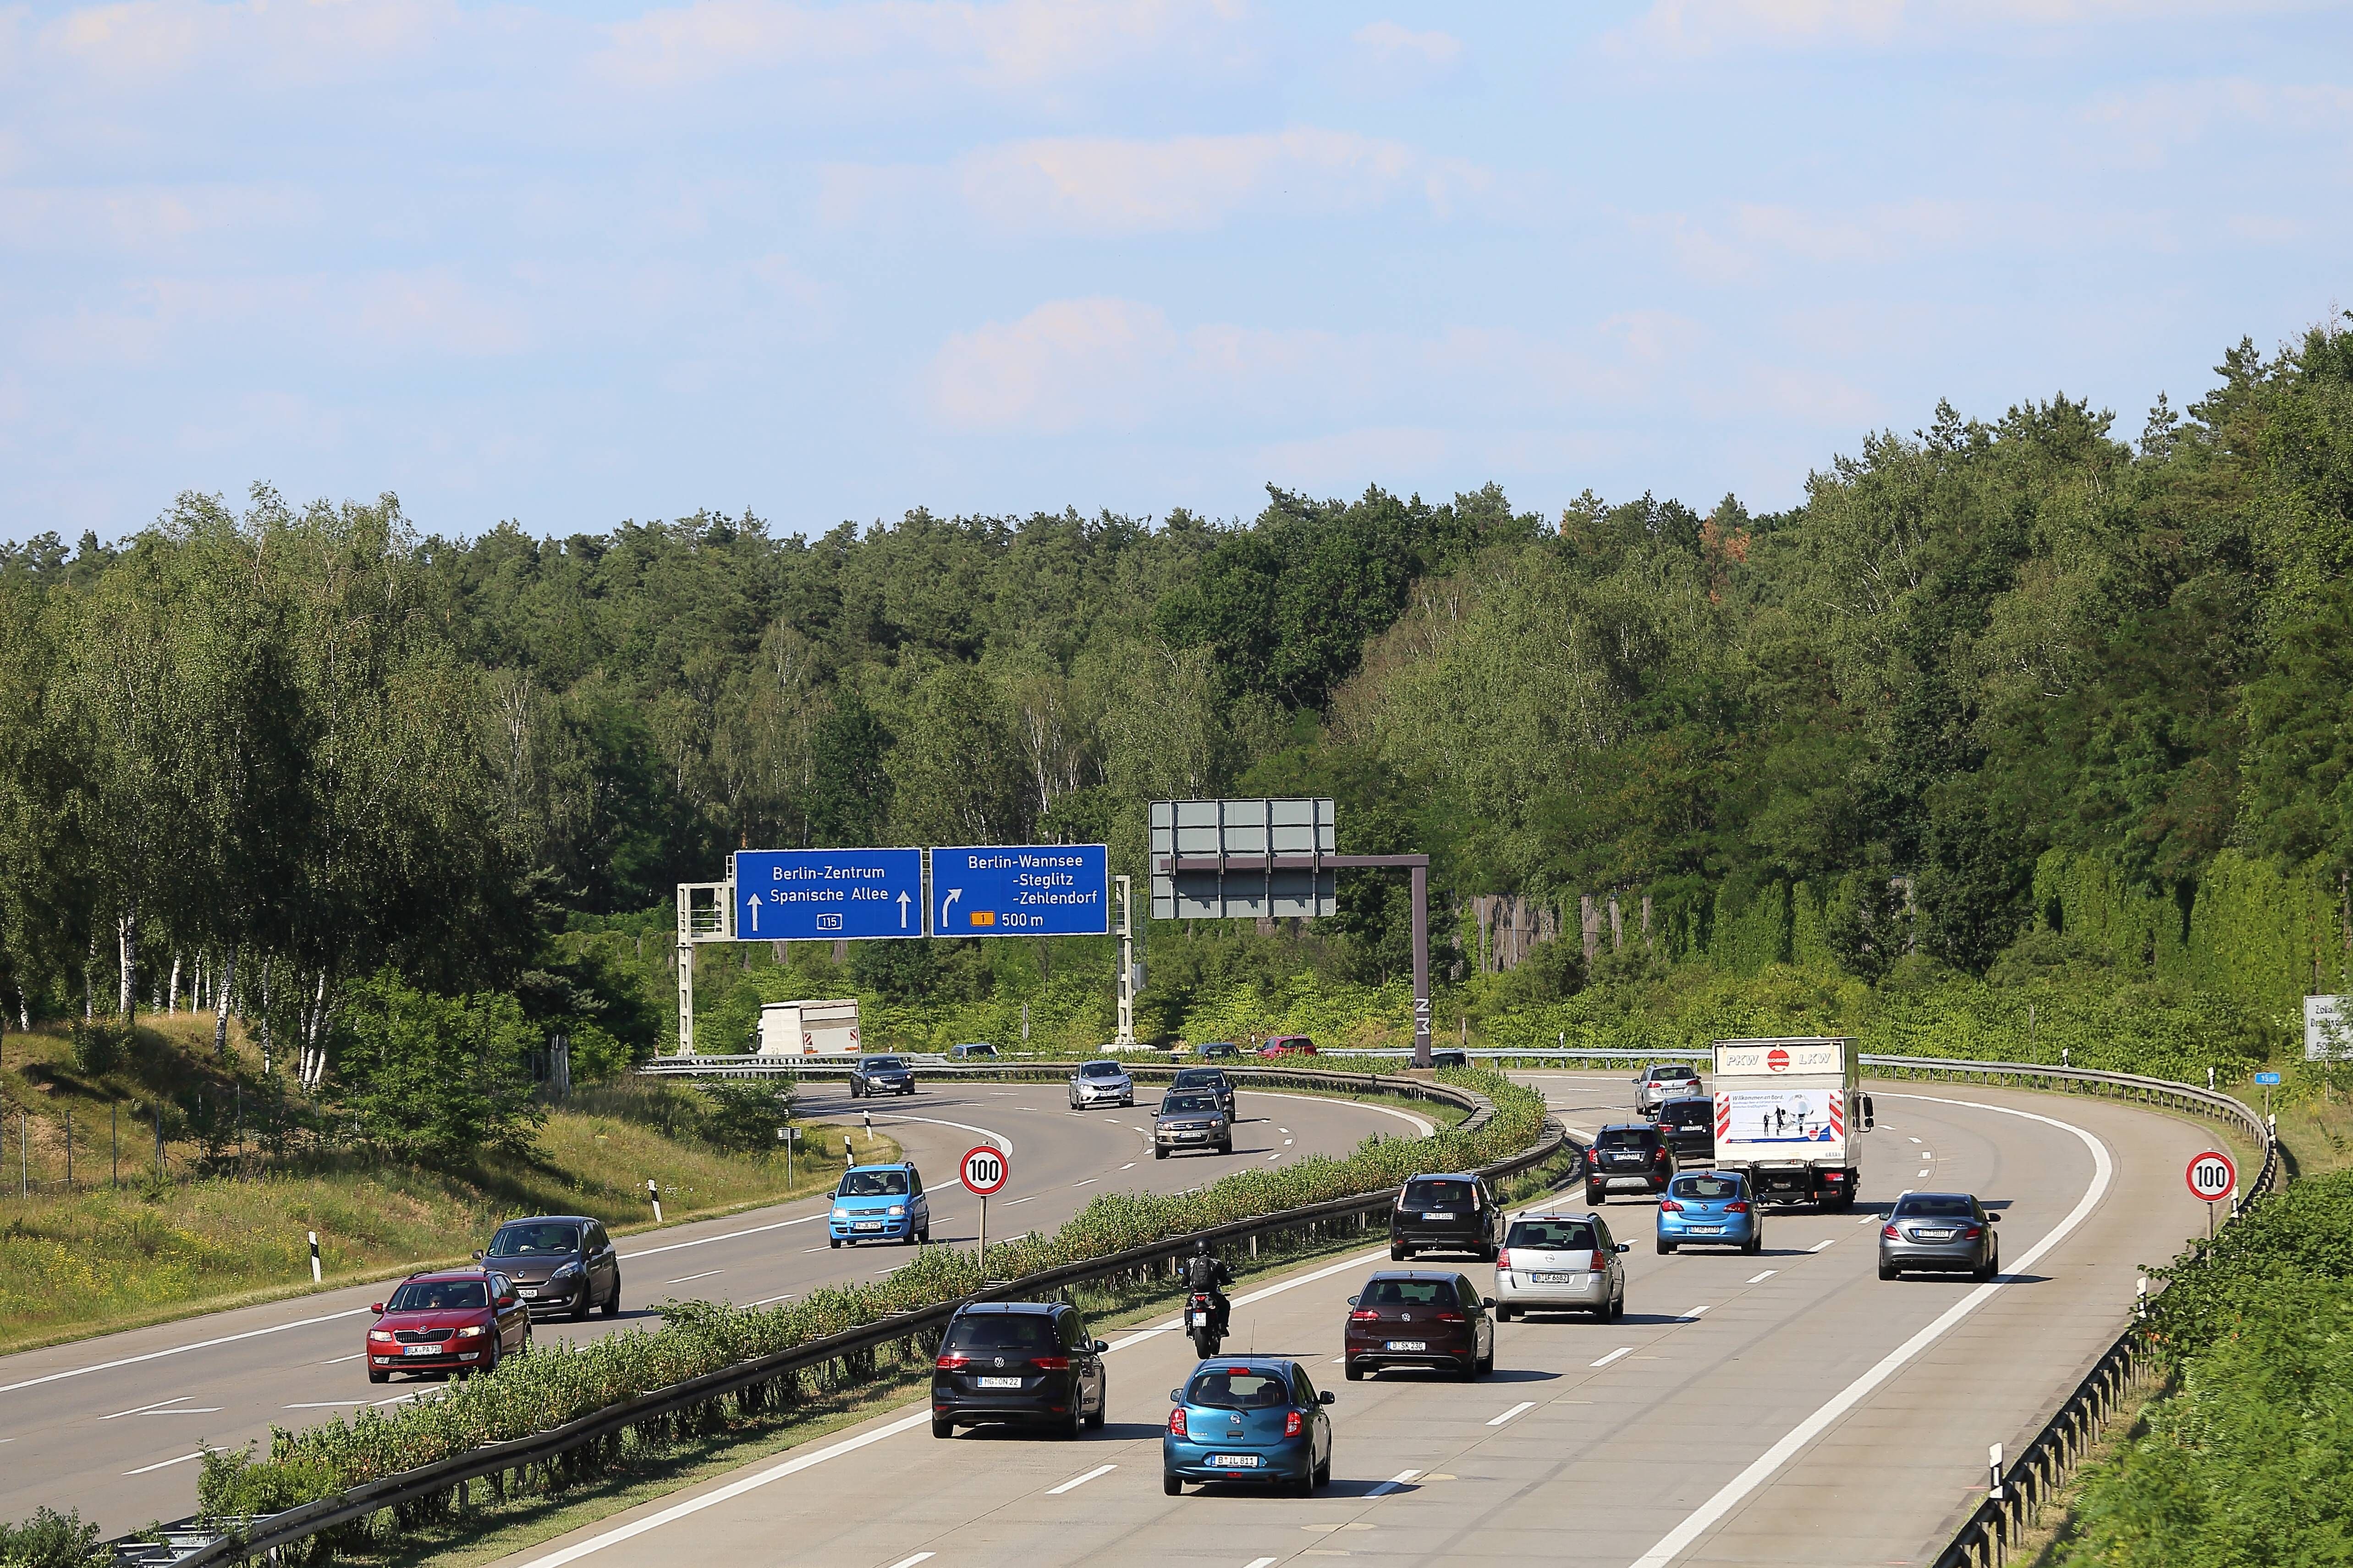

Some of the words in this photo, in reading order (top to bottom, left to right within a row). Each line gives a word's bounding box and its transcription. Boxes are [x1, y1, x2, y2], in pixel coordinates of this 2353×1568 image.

[968, 855, 1083, 869] Berlin-Wannsee
[773, 866, 885, 881] Berlin-Zentrum
[1012, 872, 1073, 889] -Steglitz
[770, 888, 844, 905] Spanische
[851, 887, 889, 900] Allee
[1012, 890, 1097, 905] -Zehlendorf
[823, 917, 837, 927] 115
[981, 914, 985, 923] 1
[1002, 913, 1027, 927] 500
[1031, 916, 1043, 926] m
[2315, 1004, 2340, 1014] Zolla
[1726, 1055, 1759, 1066] PKW
[1799, 1053, 1831, 1065] LKW
[969, 1159, 999, 1182] 100
[2196, 1166, 2225, 1188] 100
